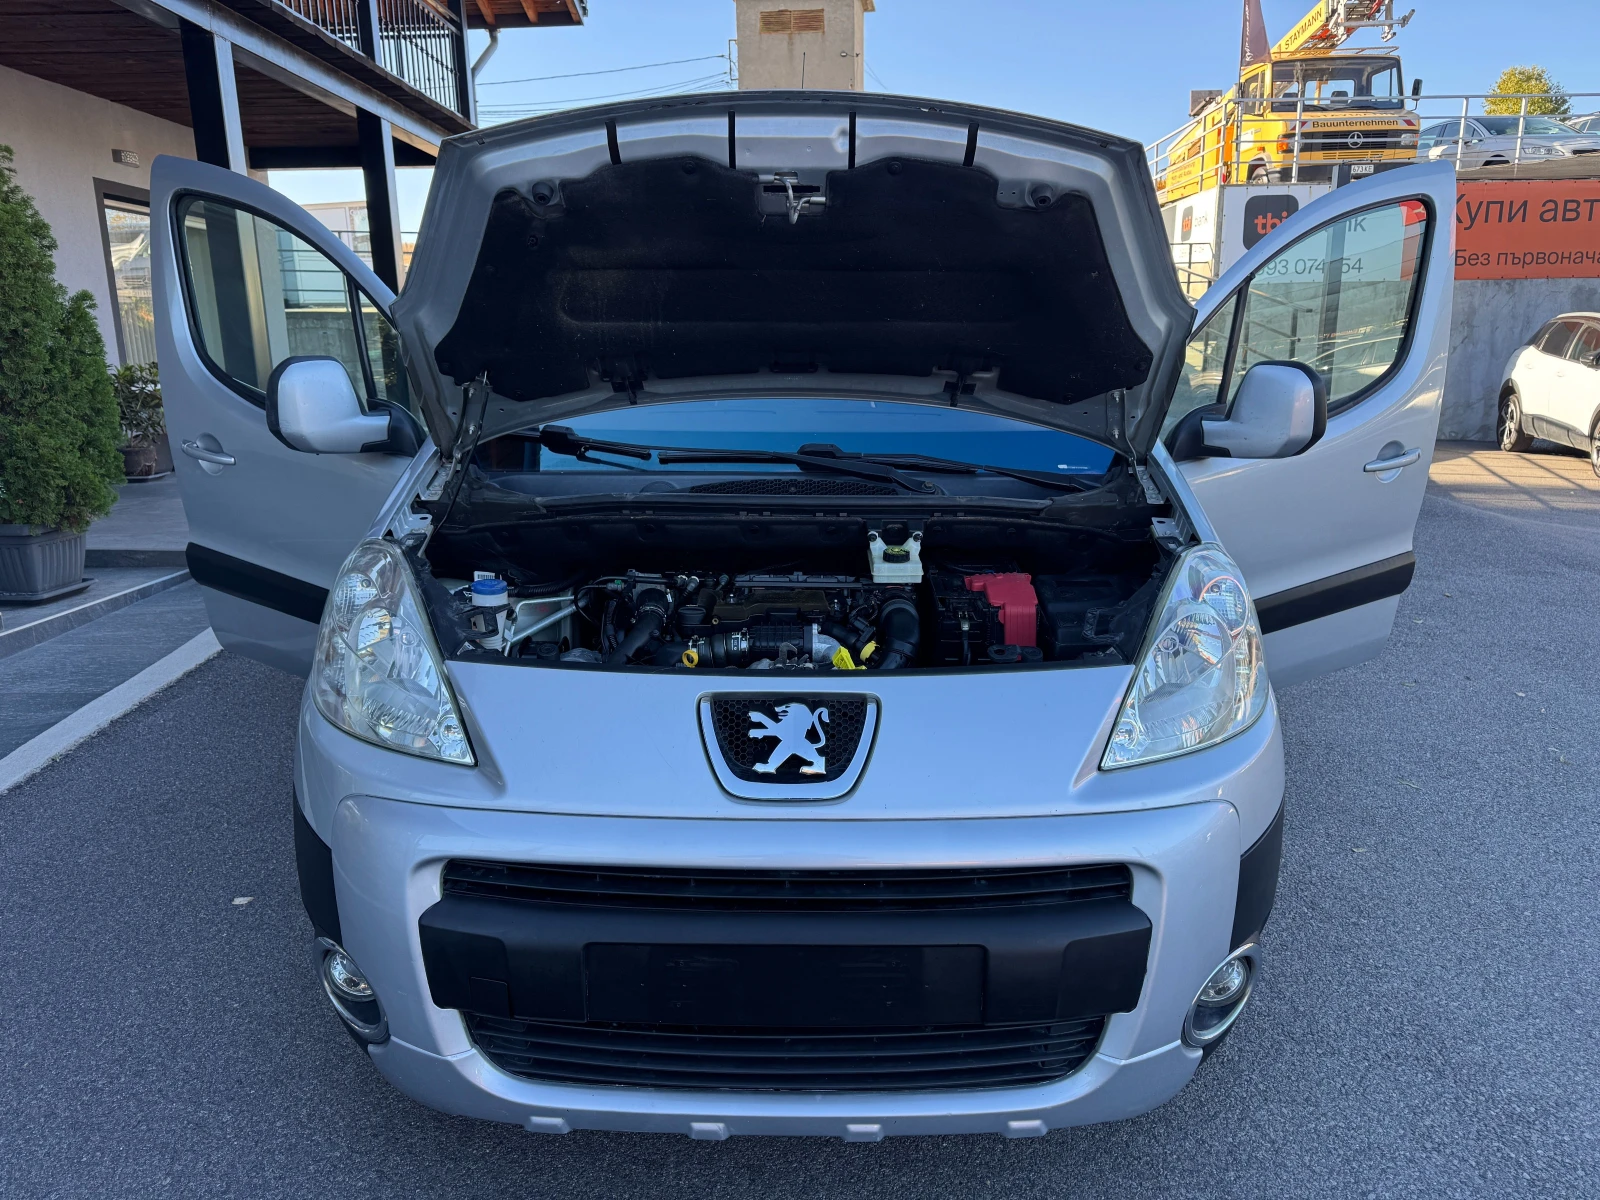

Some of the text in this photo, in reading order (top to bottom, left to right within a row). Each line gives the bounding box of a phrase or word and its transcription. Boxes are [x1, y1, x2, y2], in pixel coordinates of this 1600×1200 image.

[1285, 8, 1322, 50] STAYMANN
[1312, 119, 1399, 128] Bauunternehmen
[1539, 198, 1600, 222] авт
[1257, 259, 1289, 275] 93
[1454, 249, 1491, 267] Без
